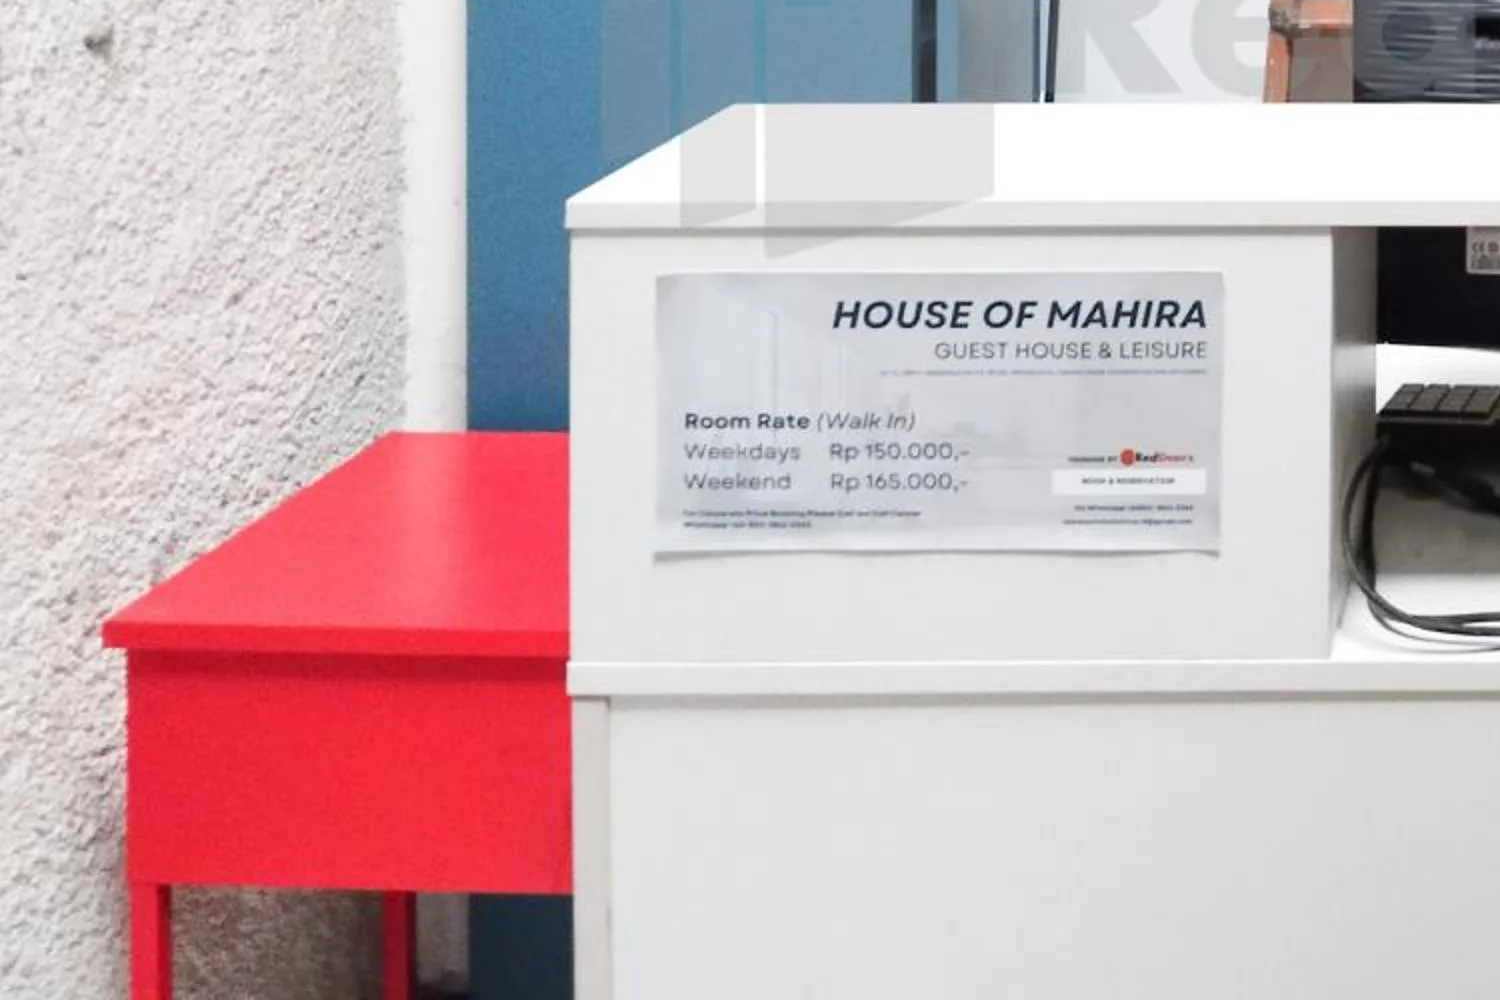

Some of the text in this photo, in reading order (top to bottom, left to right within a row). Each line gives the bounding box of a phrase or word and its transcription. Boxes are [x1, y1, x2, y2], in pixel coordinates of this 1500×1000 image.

[832, 299, 1208, 329] HOUSE OF MAHIRA
[934, 342, 1208, 360] GUEST HOUSE & LEISURE
[684, 411, 917, 432] Room Rate (Walk In)
[684, 443, 970, 464] Weekdays Rp 150.000,-
[684, 473, 968, 493] Weekend Rp 165.000,-
